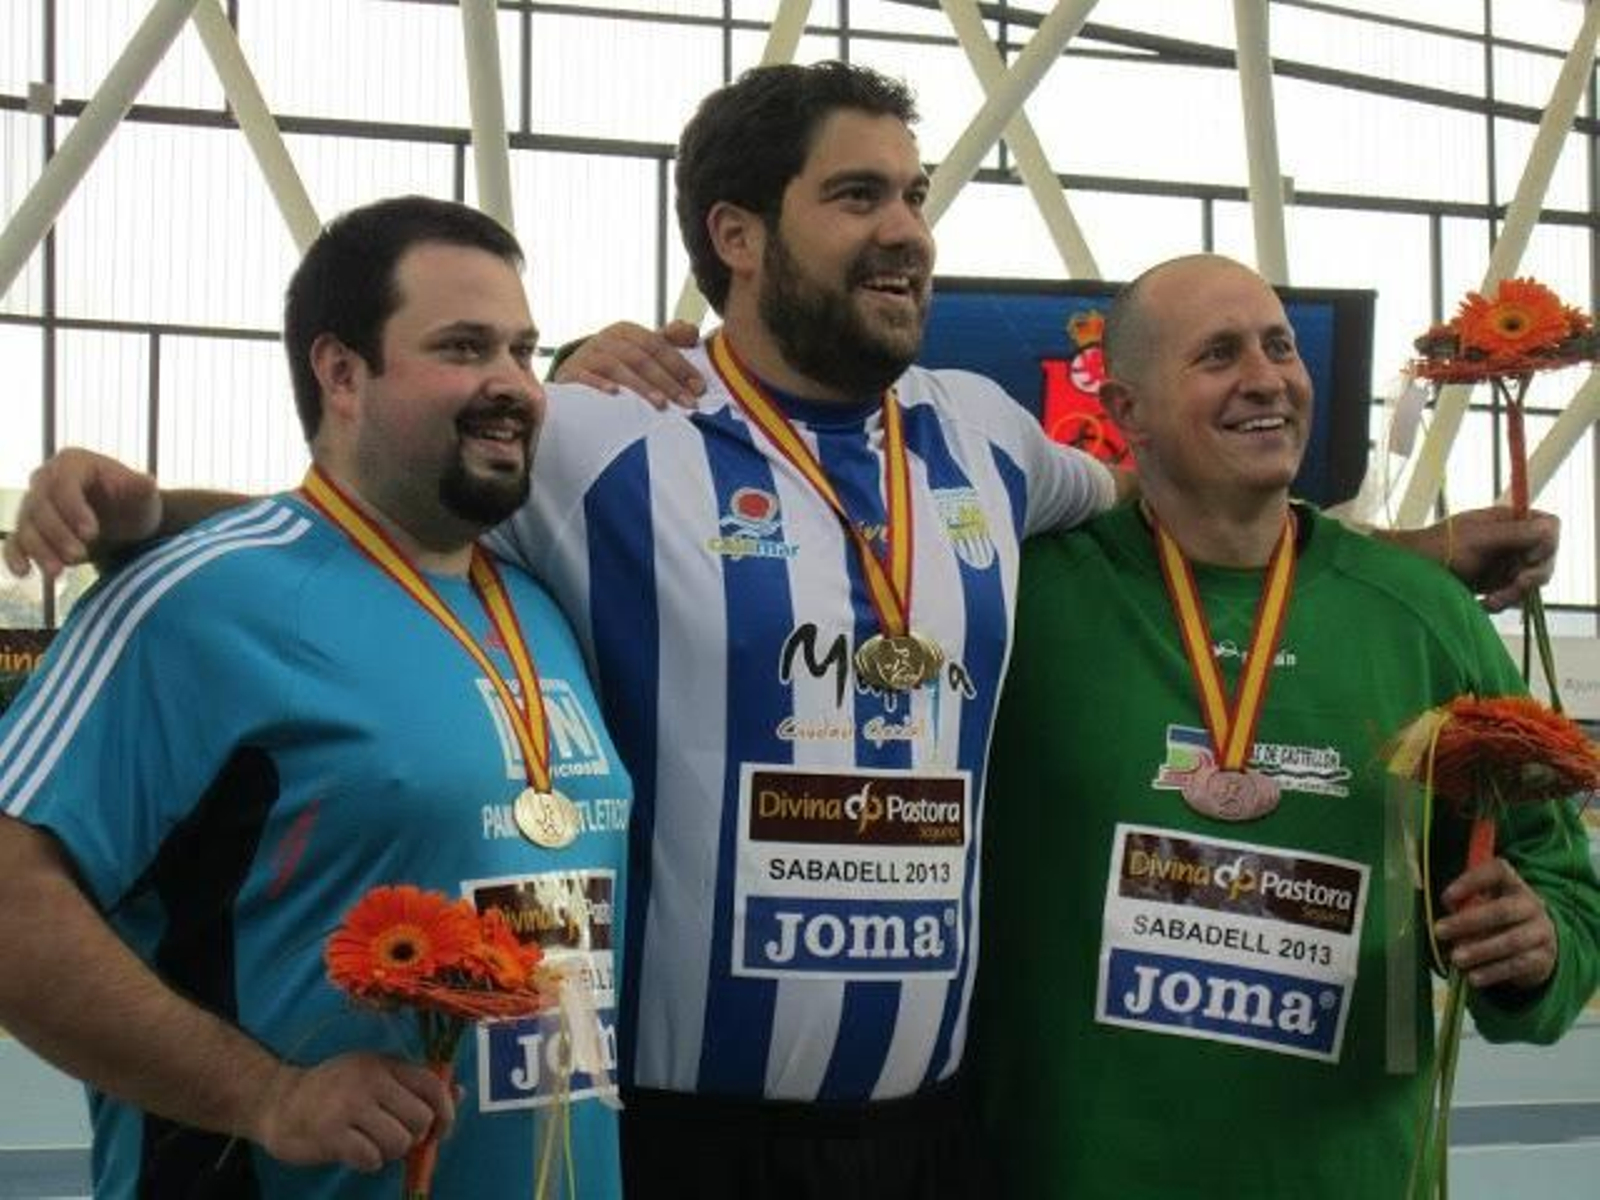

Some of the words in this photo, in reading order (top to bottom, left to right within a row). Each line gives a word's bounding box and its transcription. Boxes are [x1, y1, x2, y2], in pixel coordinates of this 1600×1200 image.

[758, 791, 840, 820] Divina
[887, 796, 961, 823] Pastora
[769, 858, 900, 883] SABADELL
[905, 863, 951, 883] 2013
[1129, 850, 1210, 885] Divina
[1260, 871, 1351, 910] Pastora
[1133, 914, 1271, 955] SABADELL
[1279, 939, 1332, 966] 2013
